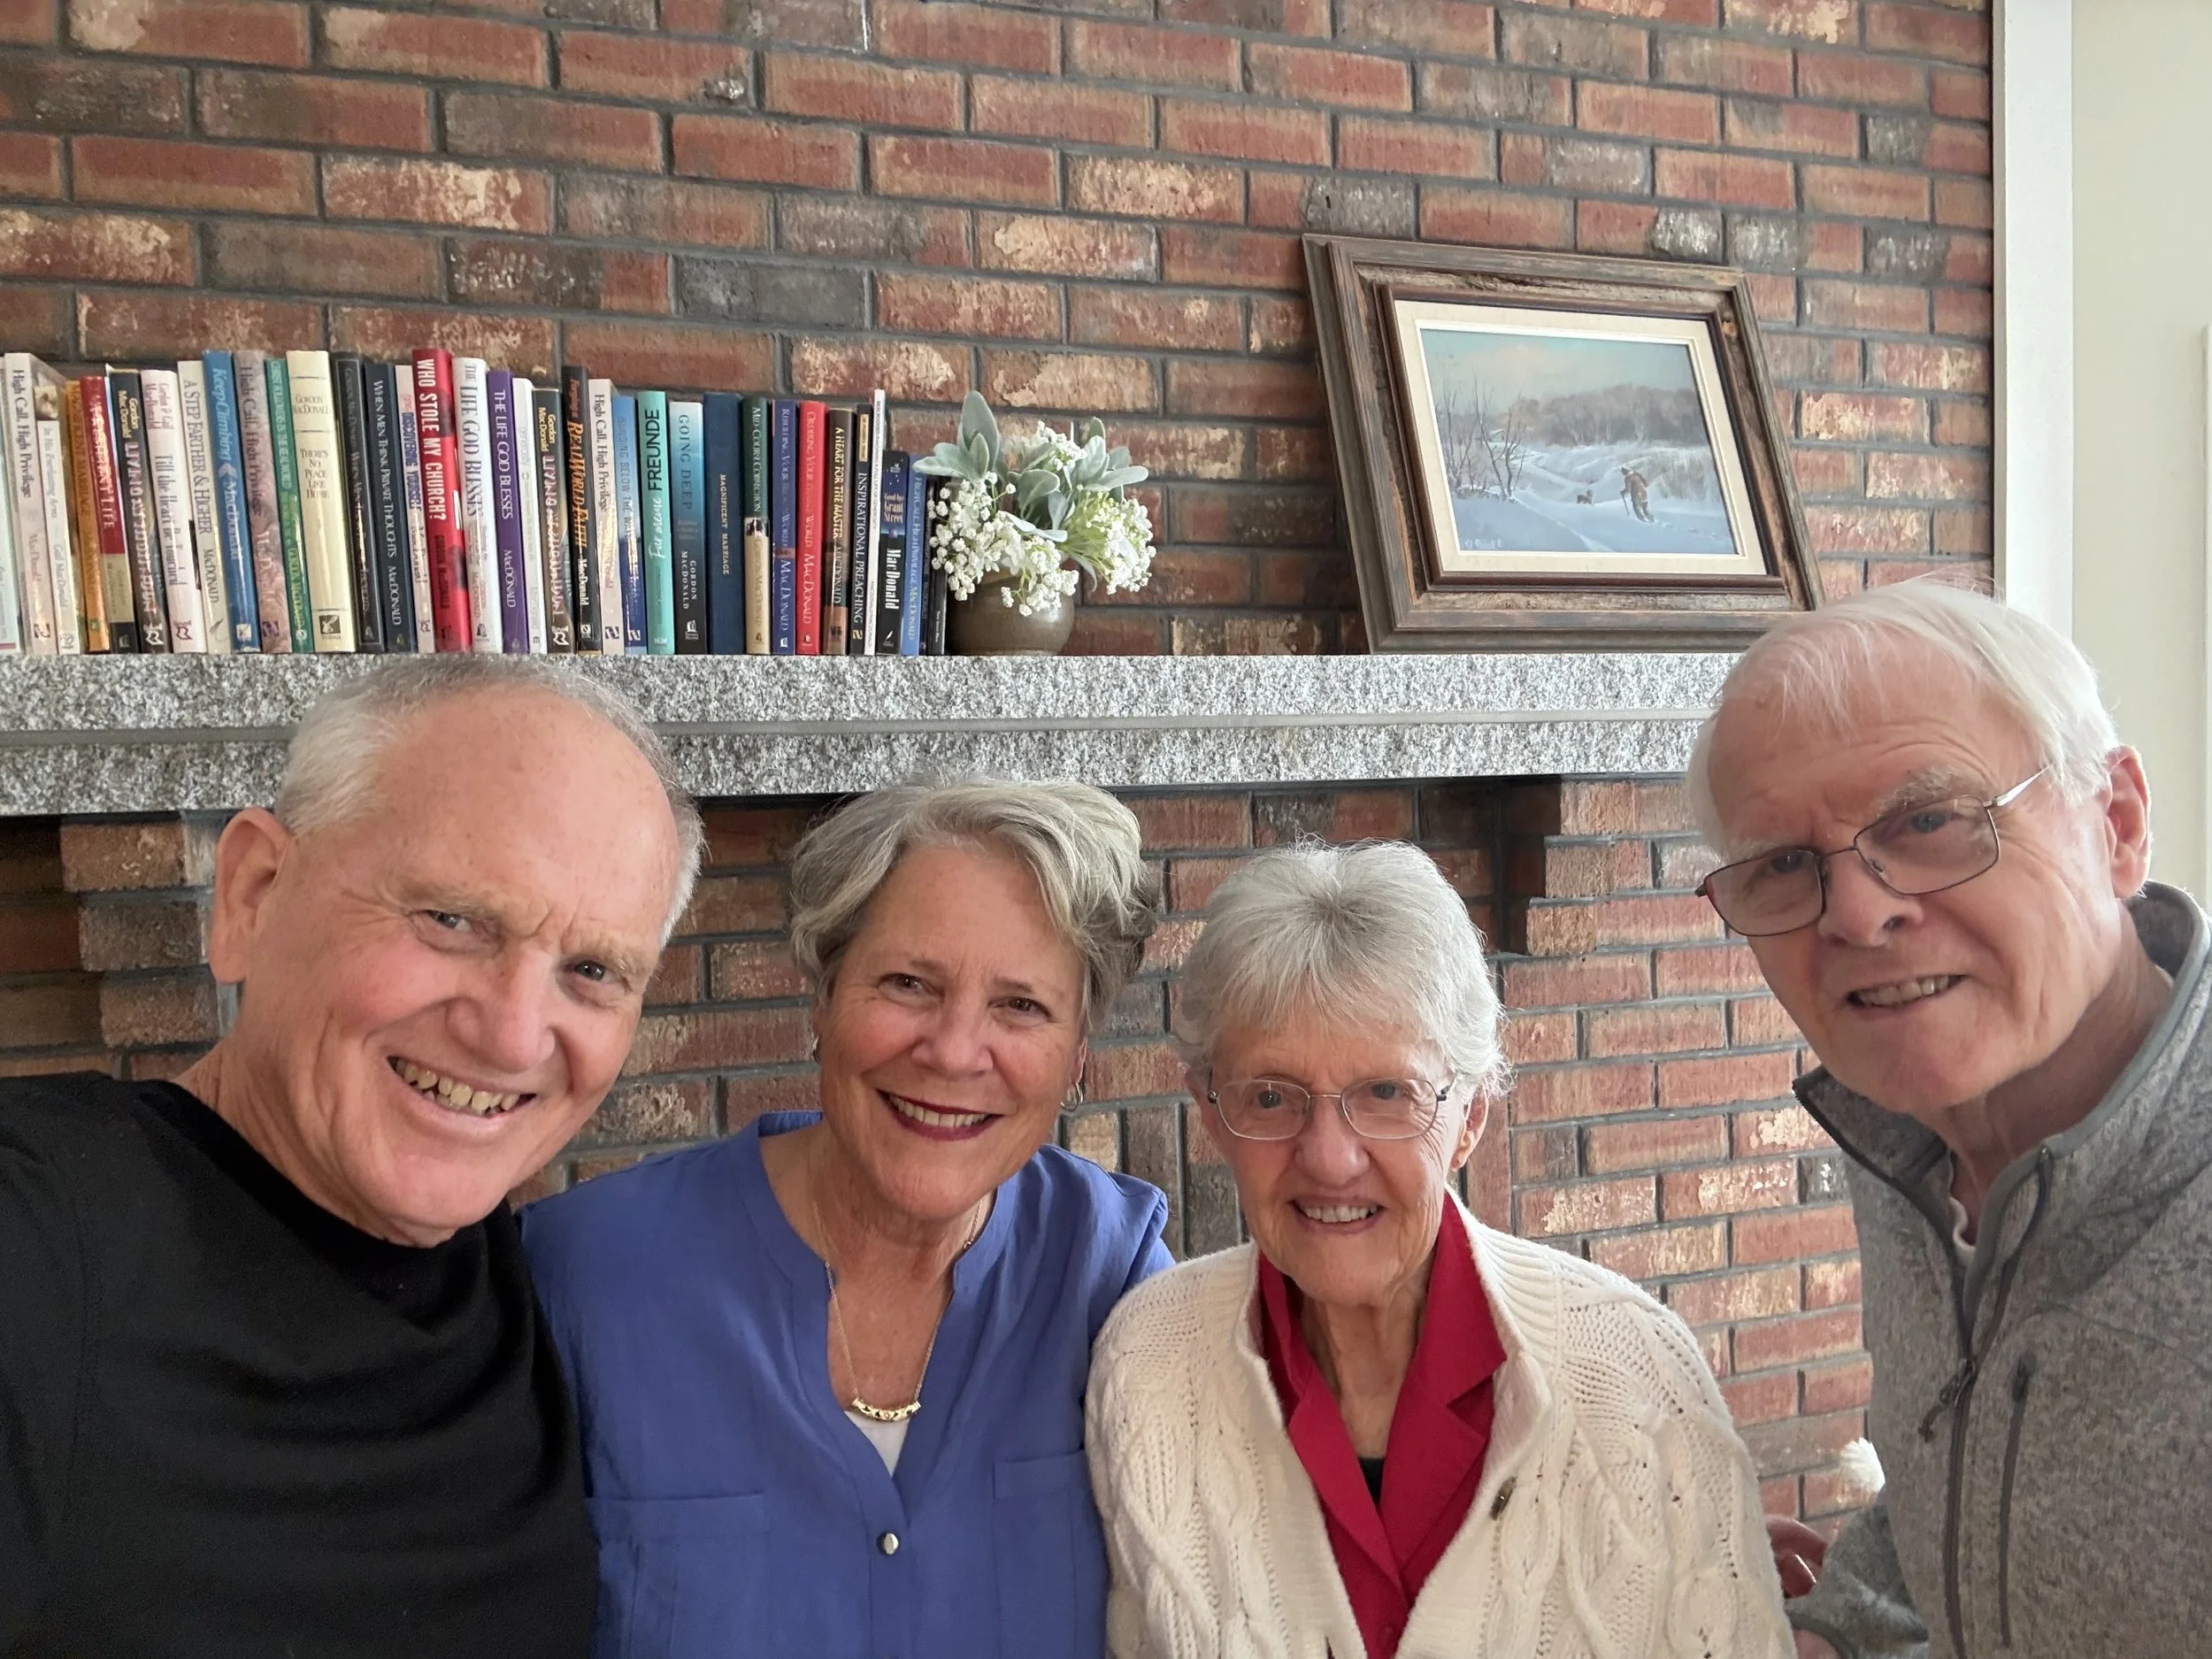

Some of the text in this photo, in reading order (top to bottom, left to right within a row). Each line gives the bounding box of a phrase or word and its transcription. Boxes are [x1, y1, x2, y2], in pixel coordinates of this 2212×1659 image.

[12, 370, 25, 394] High
[240, 366, 255, 396] High
[465, 364, 478, 381] THE
[129, 398, 140, 430] Gordon
[145, 383, 162, 431] MacDonald
[158, 383, 172, 406] Gordon
[295, 395, 324, 404] GORDON
[460, 386, 479, 417] LIFE
[594, 394, 606, 418] High
[119, 390, 133, 439] MacDonald
[162, 416, 175, 430] Gail
[211, 368, 233, 461] Keep Climbing
[538, 407, 550, 452] MacDonald
[548, 414, 557, 444] Gordon
[781, 409, 791, 453] REBUILDING
[806, 411, 818, 455] ORDERING
[16, 426, 30, 450] High
[44, 438, 55, 450] His
[71, 384, 90, 517] MAGNIFICENT MARRIAGE
[247, 431, 261, 460] High
[402, 412, 419, 466] DISCOVERING
[417, 358, 447, 520] WHO STOLE MY CHURCH?
[463, 420, 481, 455] GOD
[494, 389, 514, 520] THE LIFE GOD BLESSES
[596, 445, 609, 468] High
[618, 418, 630, 457] BUILDING
[644, 409, 663, 492] FREUNDE
[680, 414, 692, 463] GOING
[834, 435, 845, 465] HEART
[19, 453, 35, 498] Privilege
[46, 453, 58, 496] Everlasting
[125, 442, 143, 495] LIVING
[183, 380, 212, 535] A STEP FARTHER & HIGHER
[280, 463, 291, 489] WORLD
[305, 469, 328, 479] PLACE
[309, 458, 321, 468] NO
[373, 380, 397, 558] WHEN MEN THINK PRIVATE THOUGHTS
[620, 462, 632, 492] BELOW
[781, 455, 791, 480] YOUR
[806, 455, 816, 482] YOUR
[833, 466, 845, 484] FOR
[250, 464, 264, 516] Privilege
[306, 489, 330, 499] HOME
[407, 471, 423, 511] YOURSELF
[465, 460, 484, 517] BLESSES
[542, 456, 558, 508] LIVING
[598, 471, 612, 512] Privilege
[681, 469, 694, 511] DEEP
[752, 462, 764, 512] CORRECTION
[833, 487, 844, 504] THE
[913, 478, 923, 498] HIGH
[50, 497, 59, 518] Arms
[101, 497, 115, 529] LIFE
[155, 455, 188, 586] Till the Heart Be Touched
[223, 480, 242, 560] MacDonald
[622, 495, 634, 512] THE
[833, 504, 844, 540] MASTER
[856, 472, 869, 559] INSPIRATIONAL
[884, 502, 903, 512] Grant
[884, 512, 903, 524] Street
[719, 473, 730, 576] MAGNIFICENT MARRIAGE
[781, 513, 791, 547] WORLD
[804, 515, 815, 549] WORLD
[911, 523, 922, 544] HIGH
[53, 544, 69, 607] Gail MacDonald
[256, 532, 277, 603] MacDonald
[288, 548, 300, 580] GORDON
[503, 549, 517, 608] MacDONALD
[577, 557, 591, 606] MacDonald
[886, 548, 902, 610] MacDonald
[910, 545, 920, 584] PRIVILEGE
[388, 566, 403, 626] MacDONALD
[853, 560, 866, 625] PREACHING
